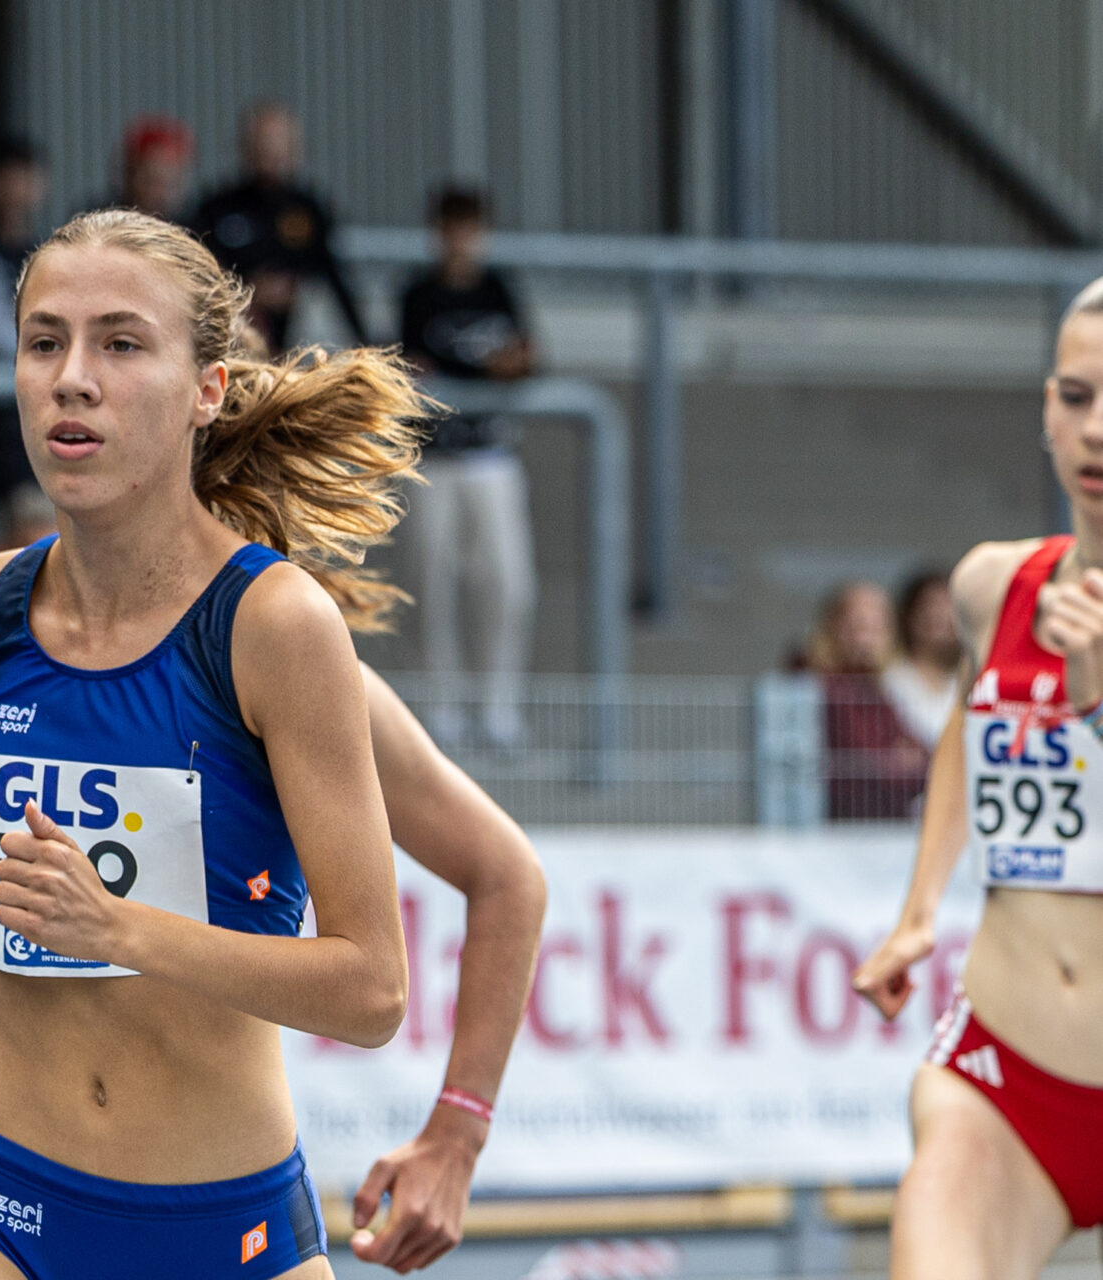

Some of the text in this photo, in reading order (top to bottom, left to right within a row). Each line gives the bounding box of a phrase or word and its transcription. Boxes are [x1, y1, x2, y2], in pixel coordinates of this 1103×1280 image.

[0, 720, 30, 735] sport
[975, 774, 1085, 840] 593
[6, 1216, 42, 1238] sport
